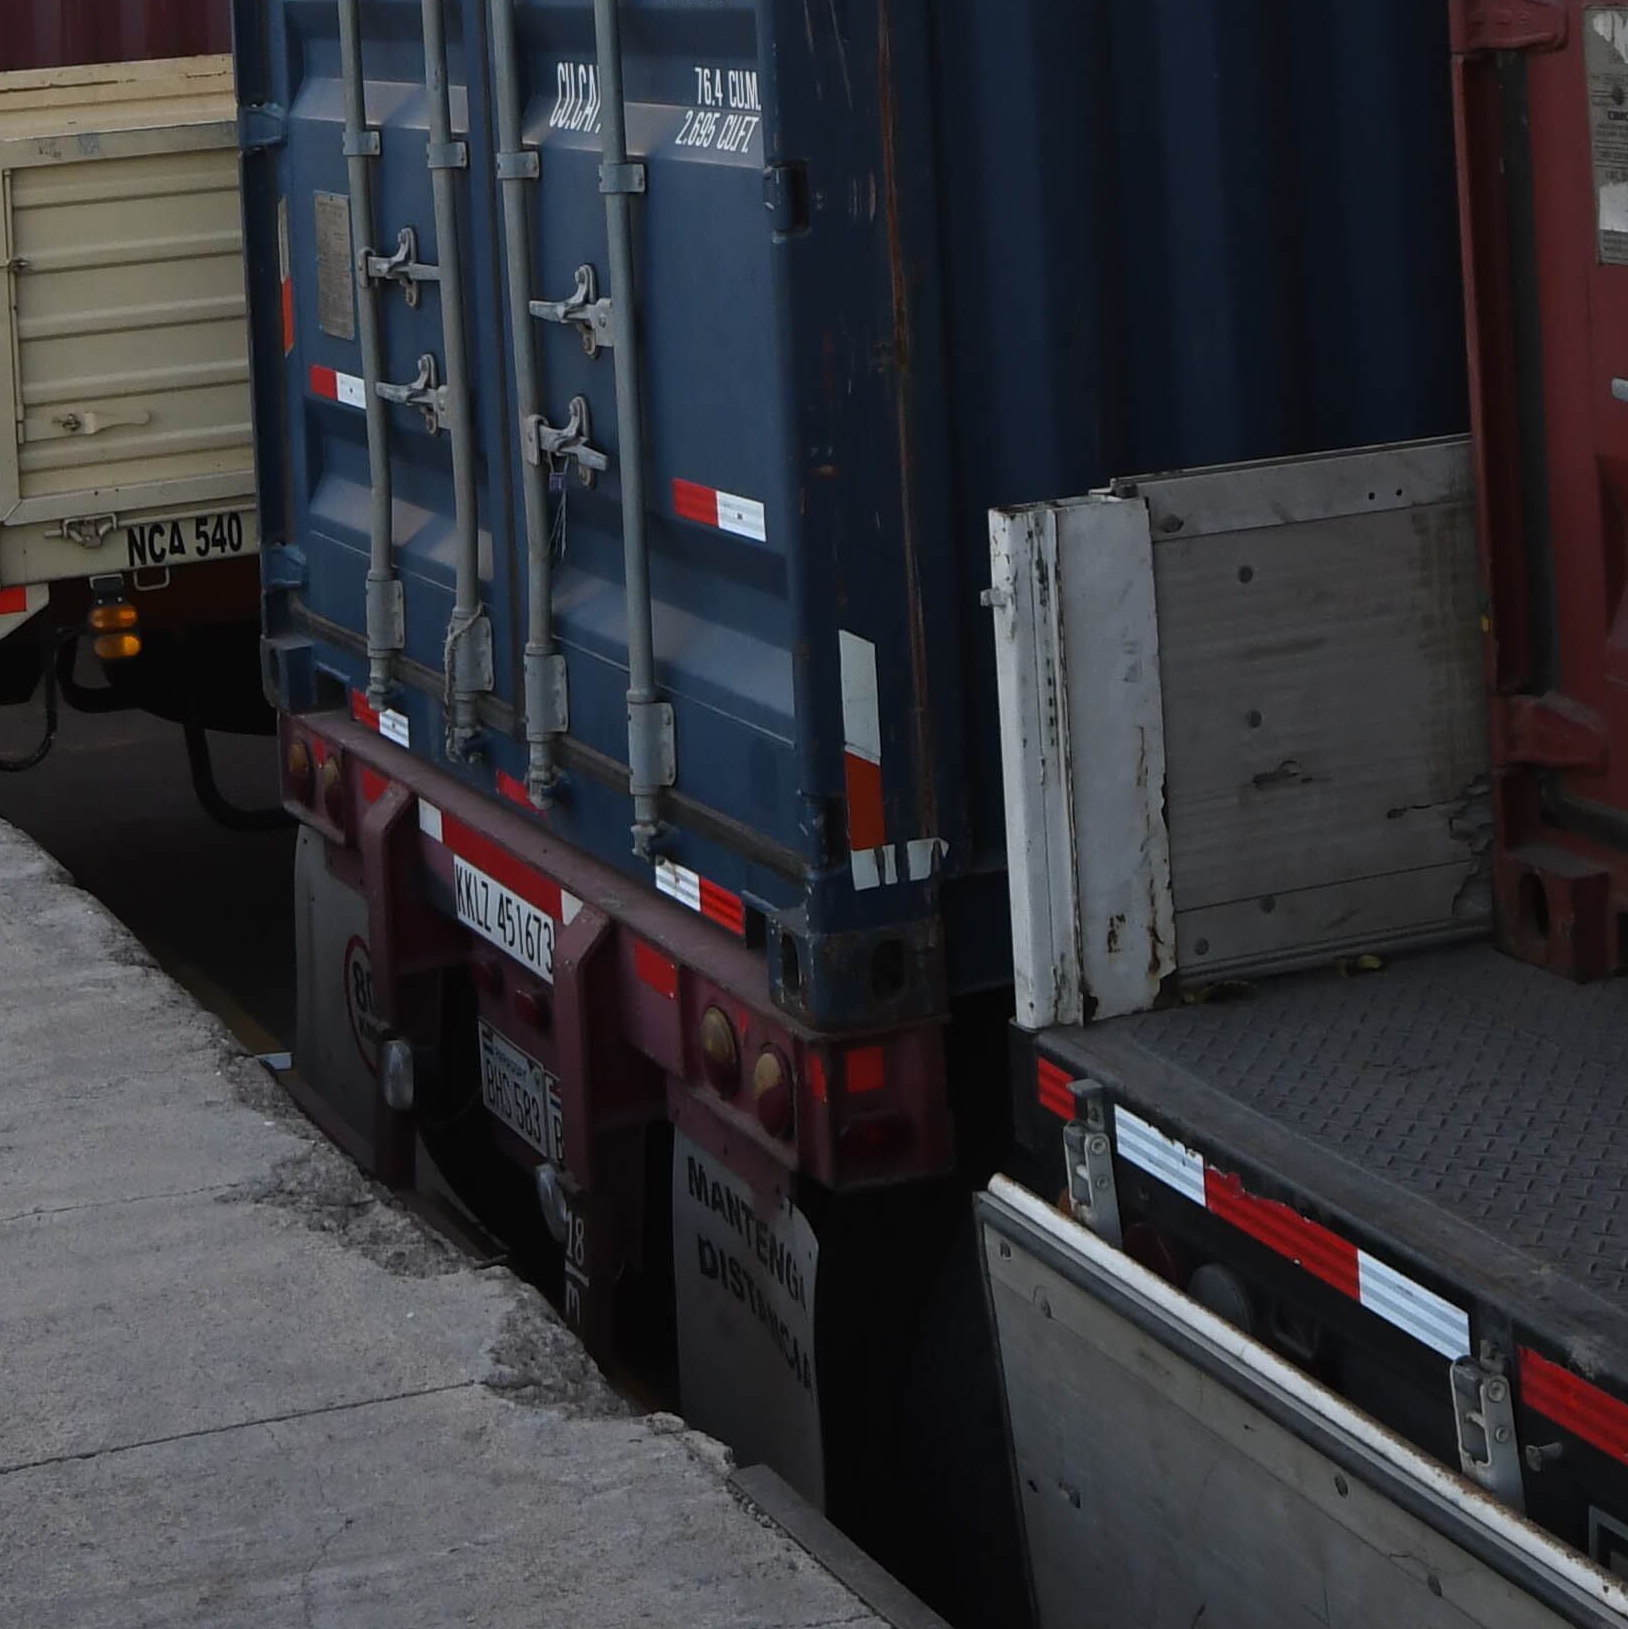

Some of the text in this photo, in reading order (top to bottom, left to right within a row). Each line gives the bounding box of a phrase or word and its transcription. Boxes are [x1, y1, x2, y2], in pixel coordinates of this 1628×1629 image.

[695, 67, 723, 107] 76.4
[674, 110, 721, 148] 2.695
[127, 512, 243, 567] NCA 540
[455, 863, 554, 975] KKLZ 451673
